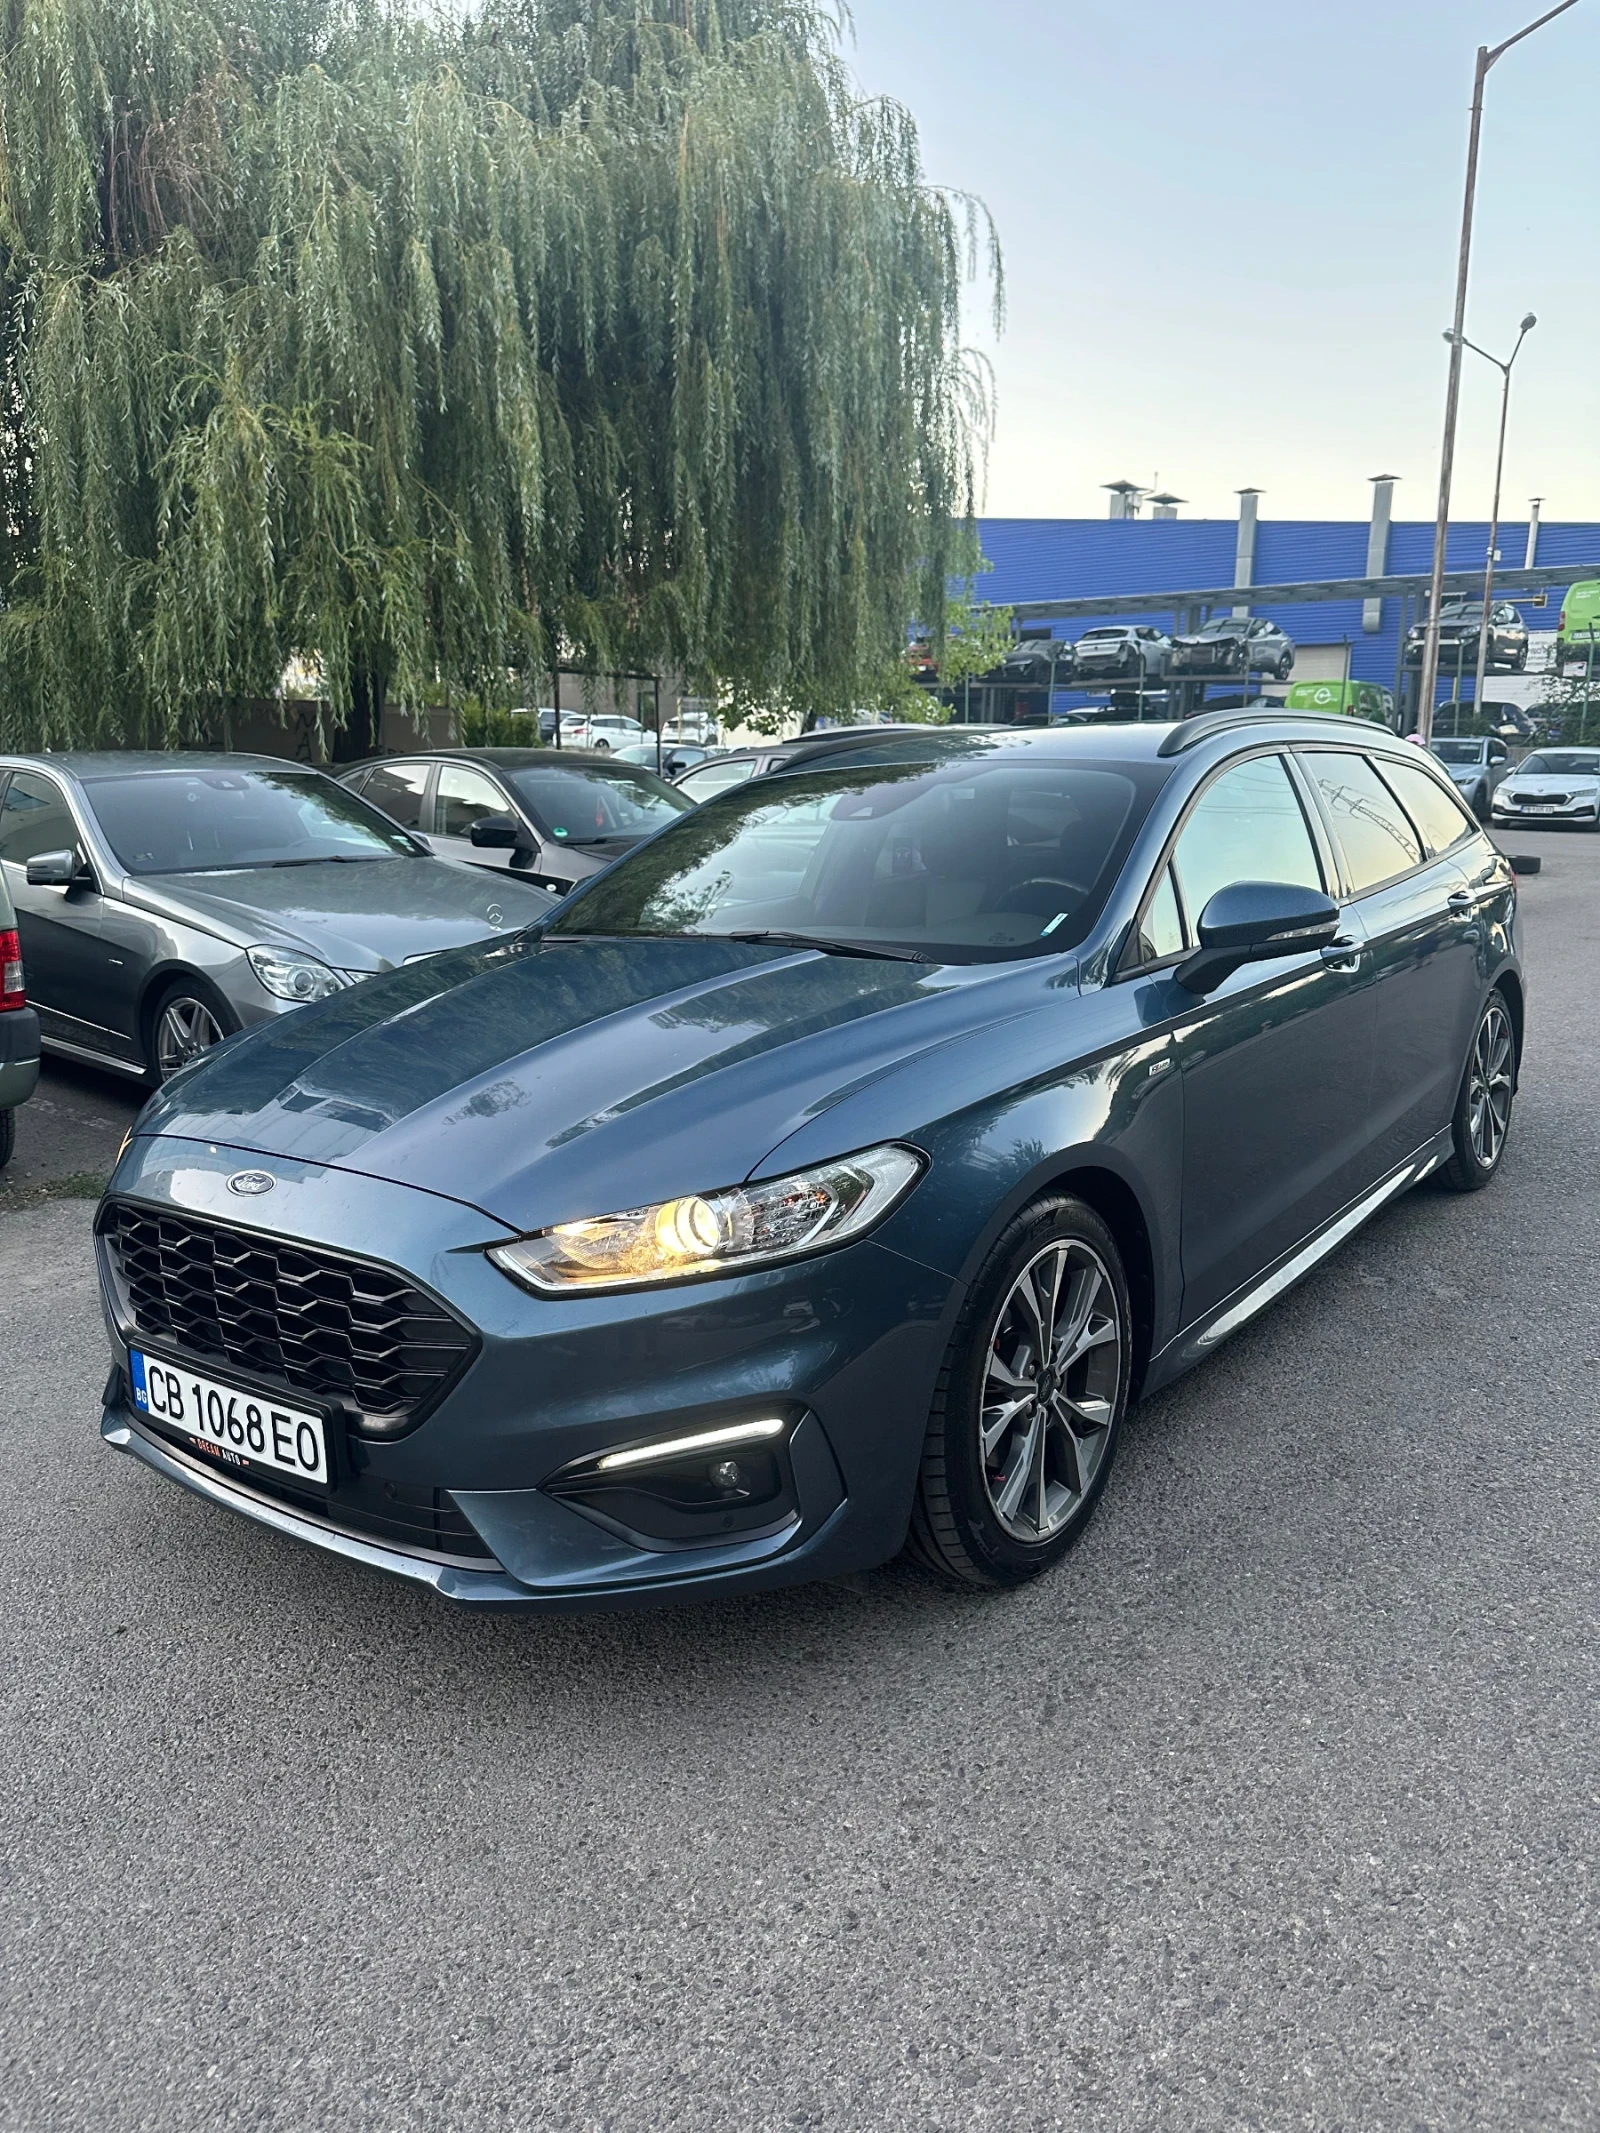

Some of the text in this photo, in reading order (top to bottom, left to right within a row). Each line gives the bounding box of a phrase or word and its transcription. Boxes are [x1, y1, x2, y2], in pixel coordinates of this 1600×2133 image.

[234, 1174, 266, 1191] Ford
[135, 1386, 148, 1404] BG
[149, 1365, 185, 1421] CB
[192, 1383, 267, 1453] 1068
[221, 1449, 241, 1466] AUTO
